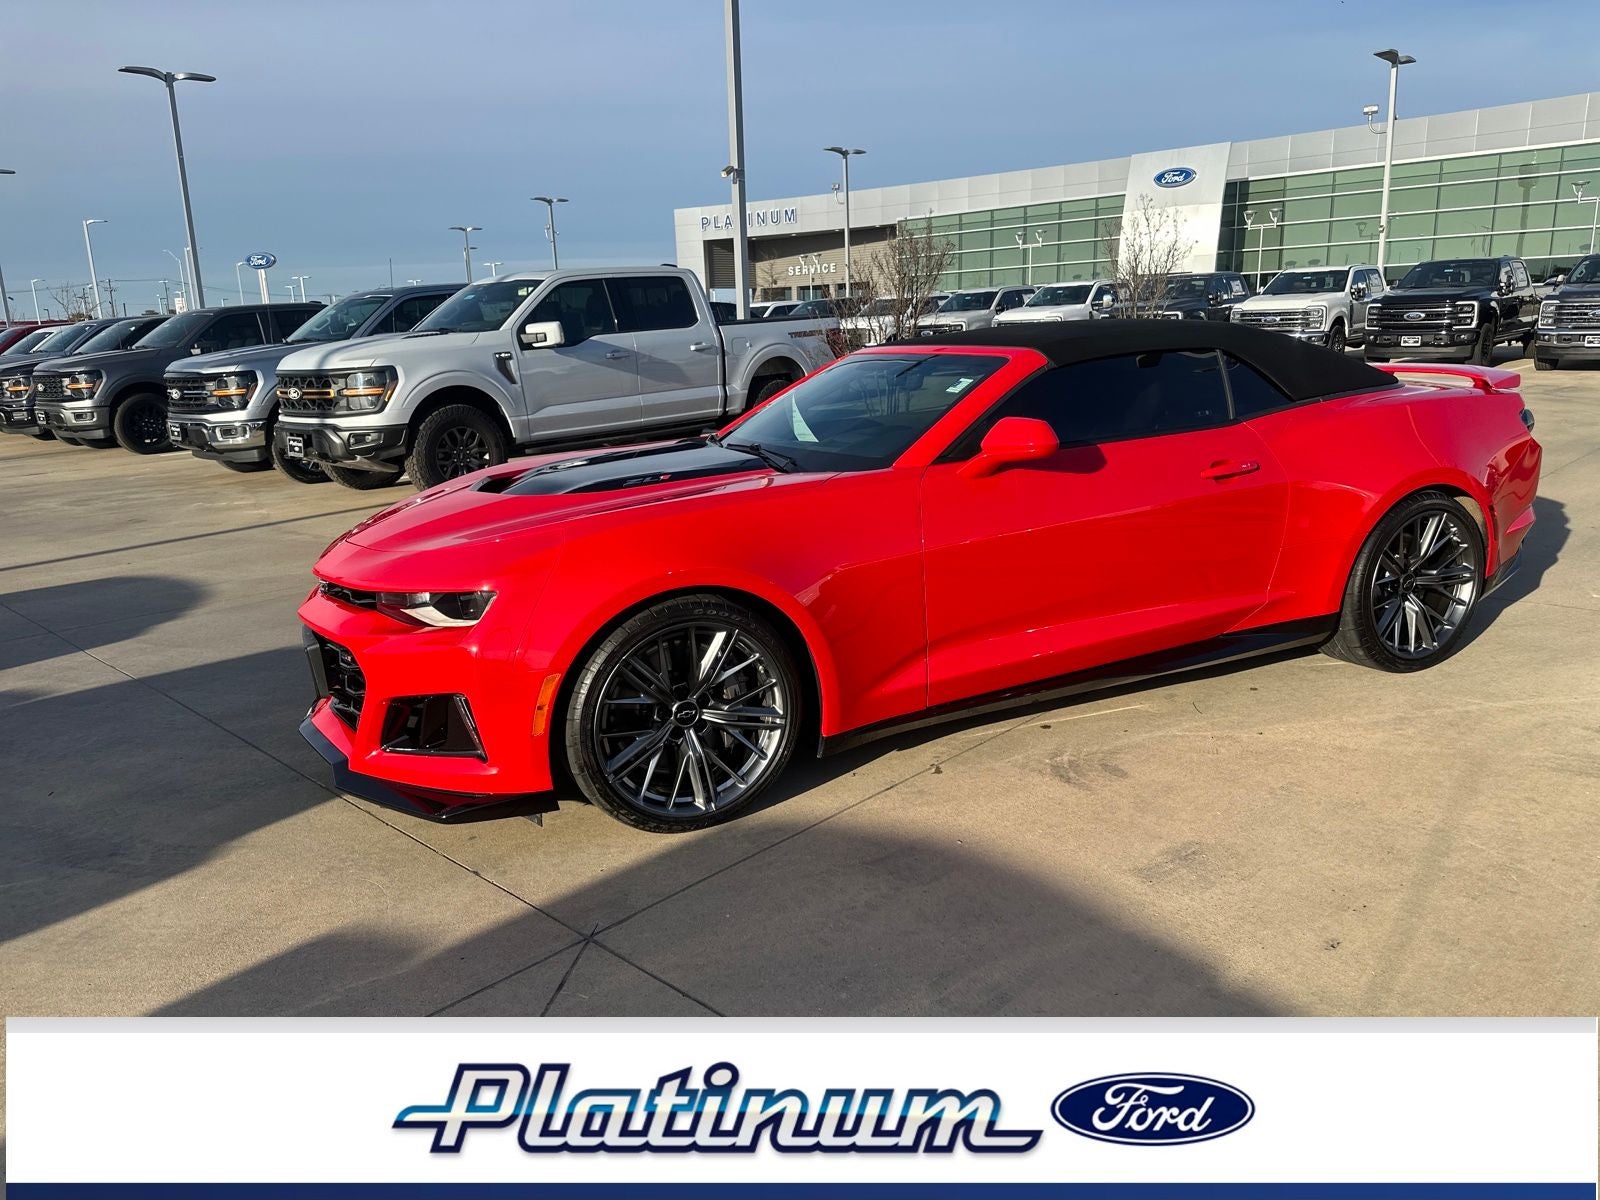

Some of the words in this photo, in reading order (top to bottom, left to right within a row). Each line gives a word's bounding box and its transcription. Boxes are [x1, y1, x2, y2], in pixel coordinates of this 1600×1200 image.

[1161, 171, 1186, 183] Ford
[701, 207, 797, 231] PLAINUM
[249, 255, 267, 266] Ford
[787, 262, 837, 276] SERVICE
